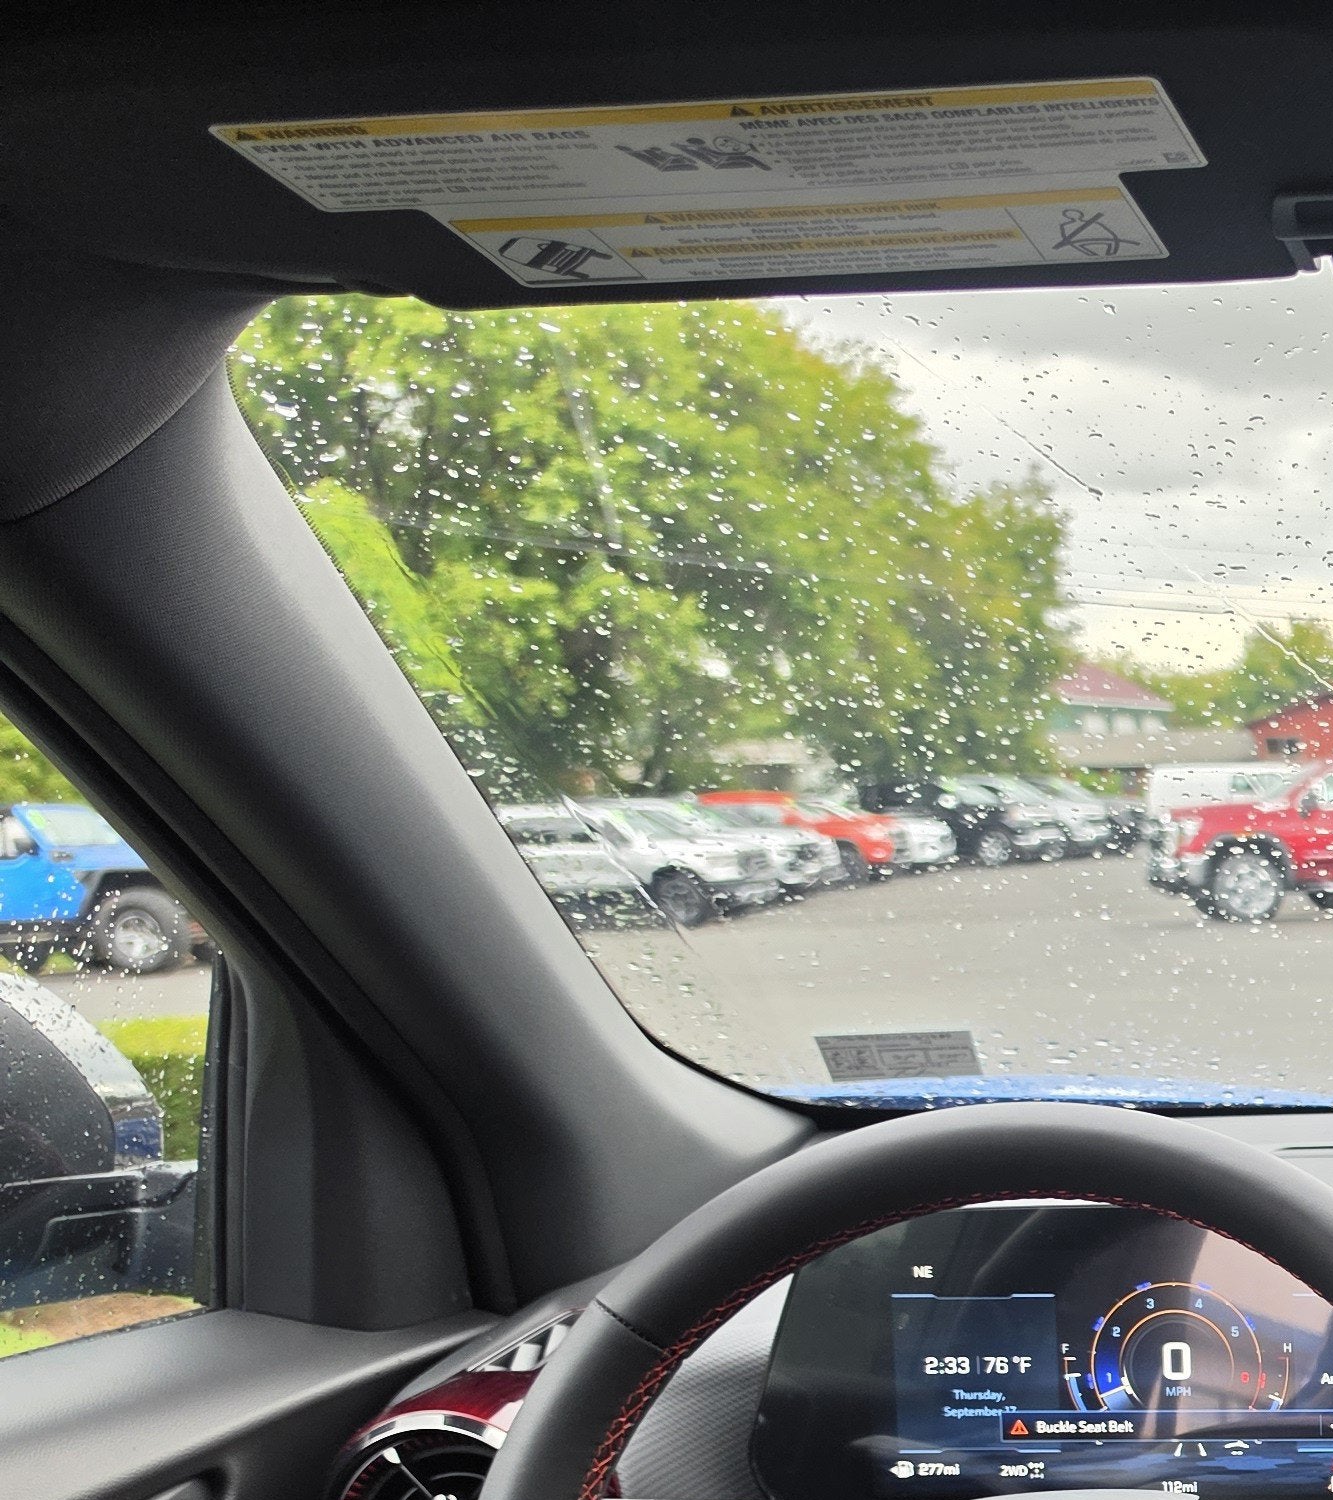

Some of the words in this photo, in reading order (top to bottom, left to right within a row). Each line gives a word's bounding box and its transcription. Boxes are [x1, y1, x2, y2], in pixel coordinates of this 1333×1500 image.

[760, 96, 934, 115] AVERTISSEMENT
[797, 117, 841, 127] AVEC
[844, 115, 879, 124] DES
[261, 126, 368, 138] WARNING
[252, 144, 307, 153] EVEN
[310, 140, 367, 150] WITH
[371, 134, 484, 147] ADVANCED
[491, 133, 528, 142] AIR
[532, 131, 590, 140] BAGS
[912, 1265, 933, 1278] NE
[1146, 1298, 1155, 1309] 3
[1195, 1298, 1203, 1309] 4
[1112, 1326, 1121, 1337] 2
[1230, 1326, 1239, 1337] 5
[1061, 1343, 1070, 1354] F
[1283, 1343, 1292, 1353] H
[924, 1356, 970, 1374] 2:33
[1162, 1341, 1191, 1381] 0
[1106, 1372, 1112, 1383] 1
[952, 1389, 1006, 1402] Thursday,
[1165, 1386, 1191, 1397] MPH
[943, 1406, 1001, 1419] September
[1036, 1420, 1077, 1433] Buckle
[1079, 1420, 1107, 1433] Seat
[1108, 1420, 1134, 1433] Belt
[917, 1463, 961, 1476] 277mi
[1000, 1464, 1028, 1477] 2WD
